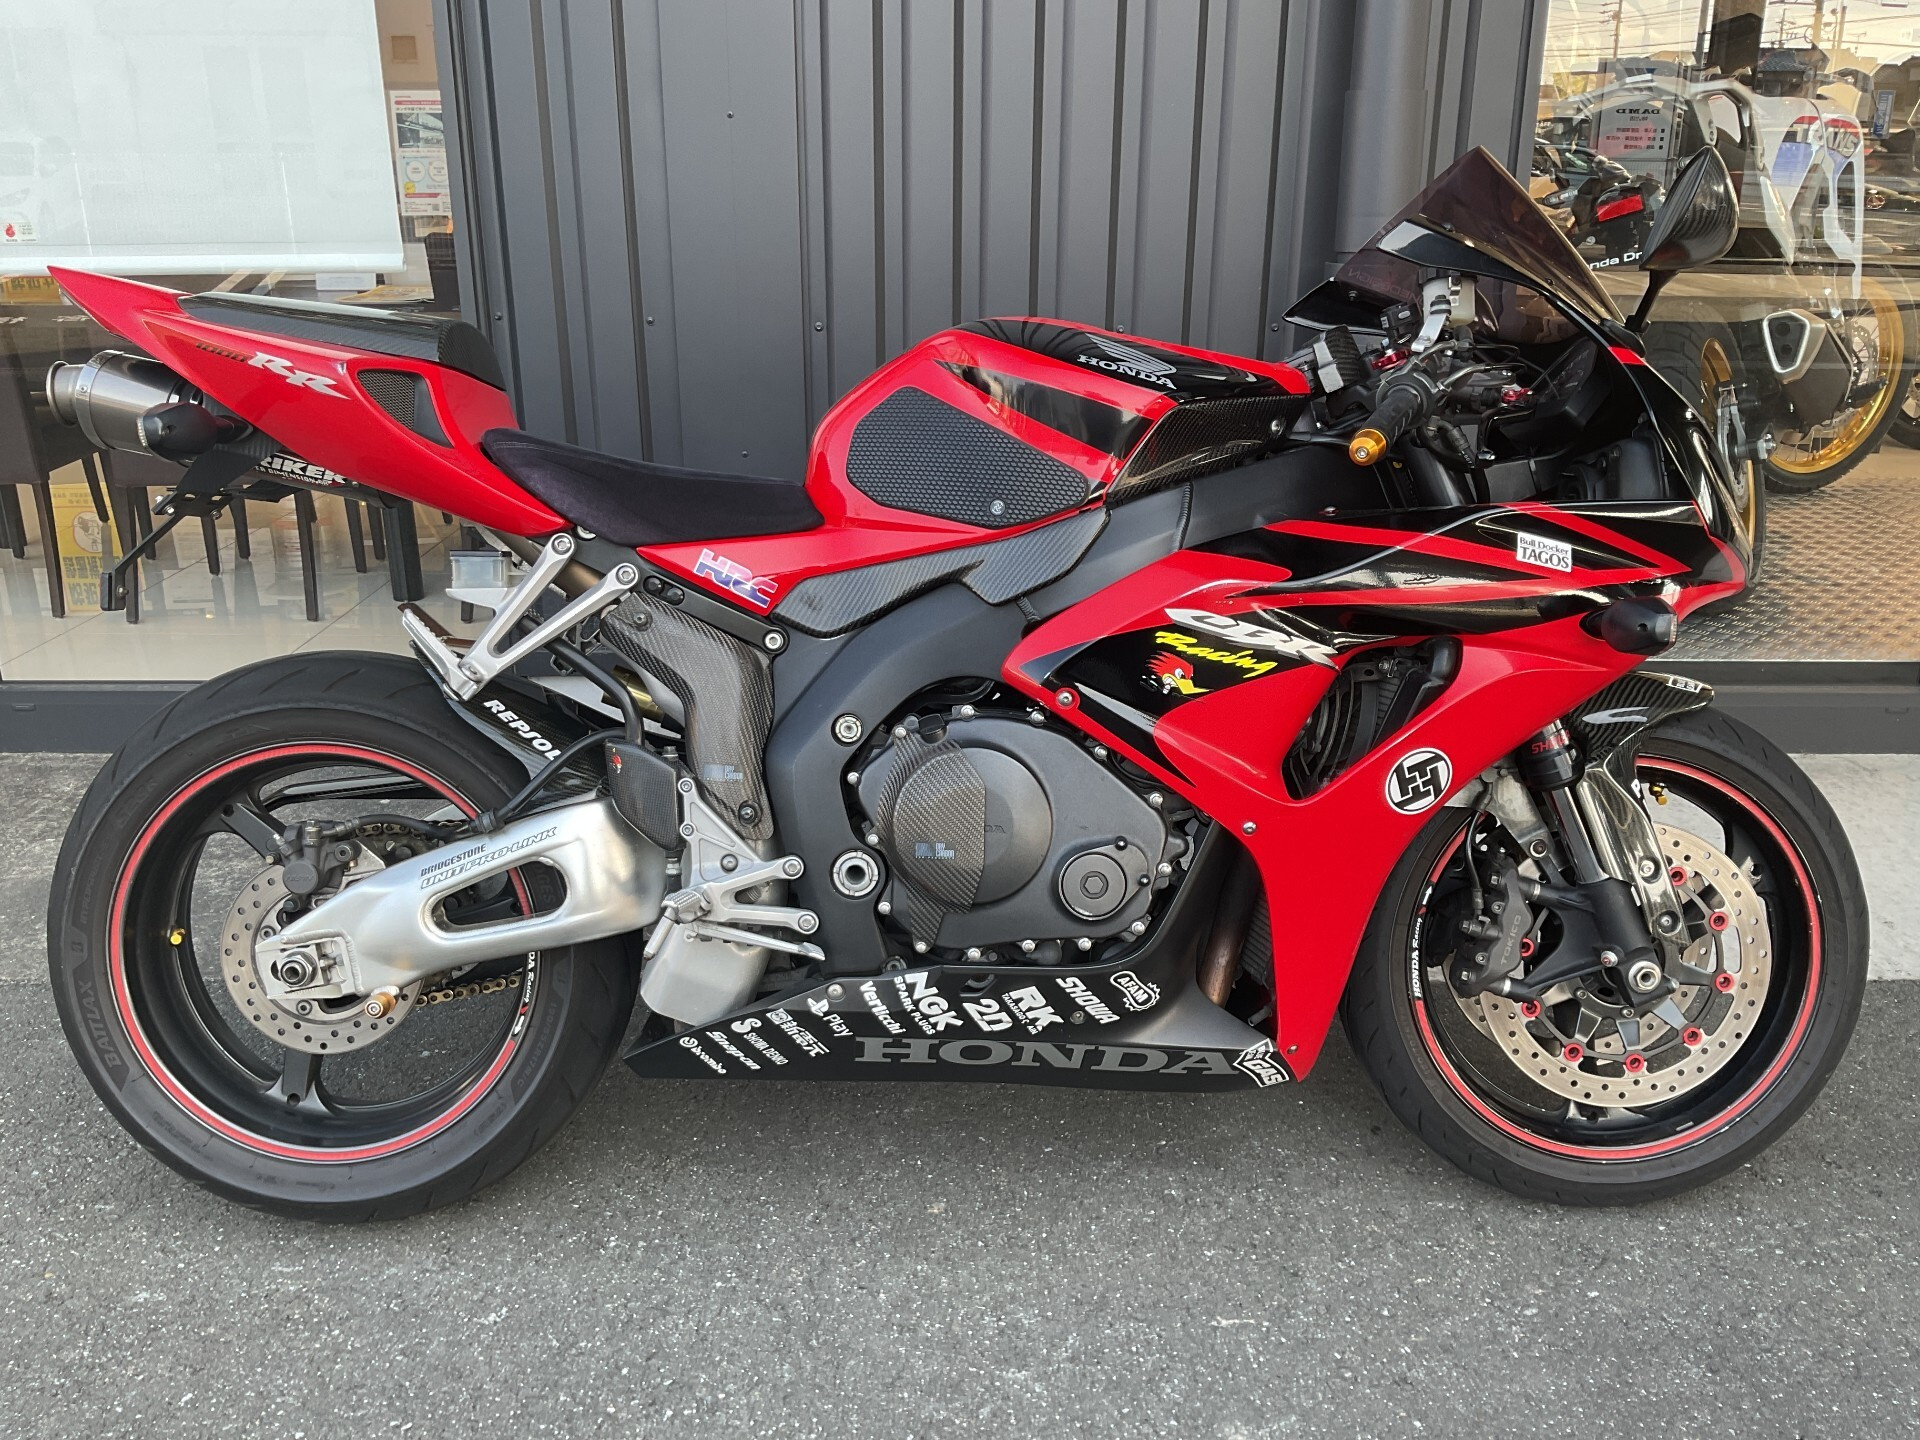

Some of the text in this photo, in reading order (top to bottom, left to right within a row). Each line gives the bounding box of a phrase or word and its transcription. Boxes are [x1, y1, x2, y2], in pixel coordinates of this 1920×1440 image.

[247, 352, 351, 400] RR
[1077, 355, 1177, 390] HONDA
[1520, 537, 1569, 555] Bull Docker
[1520, 546, 1569, 568] TAGOS
[694, 548, 778, 608] HRC
[1155, 631, 1278, 678] Racing
[483, 699, 562, 761] REPSOL
[420, 843, 487, 877] BRIDGESTONE
[420, 862, 466, 889] UNIT
[1501, 914, 1521, 965] TOKICO
[1116, 976, 1149, 1003] AFAM
[1411, 949, 1422, 998] HONDA
[860, 981, 906, 1034] Verlicchi
[894, 975, 936, 1035] SPARK PLUGS
[904, 972, 964, 1031] NGK
[962, 998, 1014, 1032] 2D
[1001, 993, 1026, 1020] TAKASAGO
[1008, 985, 1065, 1032] RK
[1056, 976, 1121, 1024] SHOWA
[78, 980, 122, 1068] BATTLAX
[823, 1013, 853, 1037] Play
[691, 1046, 727, 1074] brembo
[743, 1032, 789, 1065] SHOWA DENKO
[855, 1036, 1240, 1075] HONDA
[1243, 1060, 1283, 1086] GAS
